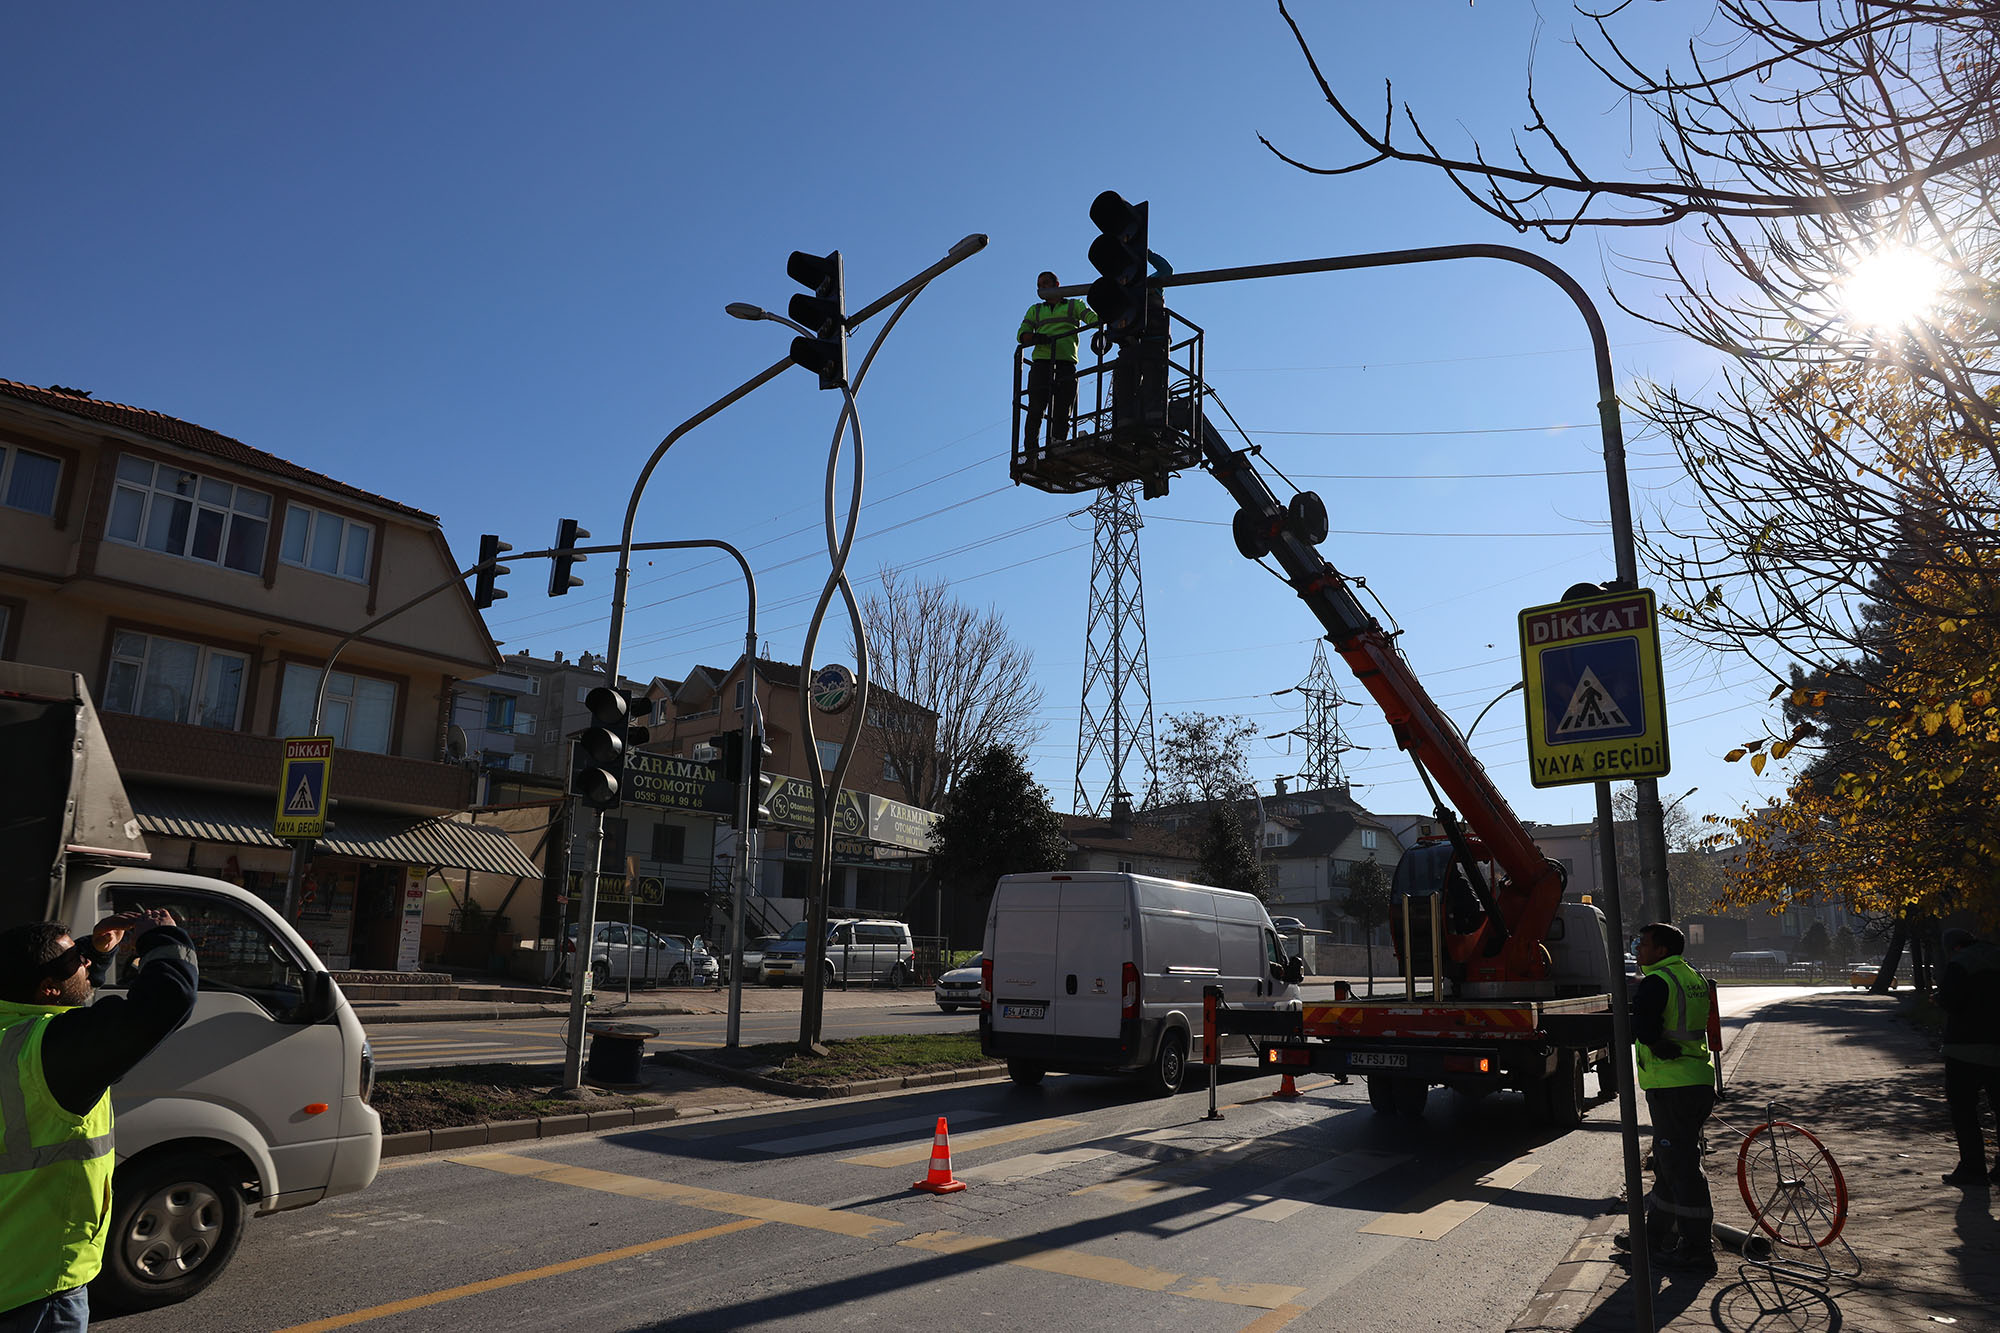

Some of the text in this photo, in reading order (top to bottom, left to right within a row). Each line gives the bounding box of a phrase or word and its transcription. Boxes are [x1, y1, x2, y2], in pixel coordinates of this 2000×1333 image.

[1532, 605, 1640, 643] DİKKAT
[287, 742, 328, 757] DİKKAT
[1537, 741, 1661, 776] YAYA GEÇİDİ
[624, 754, 716, 782] KARAMAN
[633, 775, 706, 795] OTOMOTİV
[634, 790, 656, 801] 0535
[890, 804, 928, 826] KARAMAN
[277, 821, 295, 833] YAYA
[1352, 1054, 1363, 1064] 34
